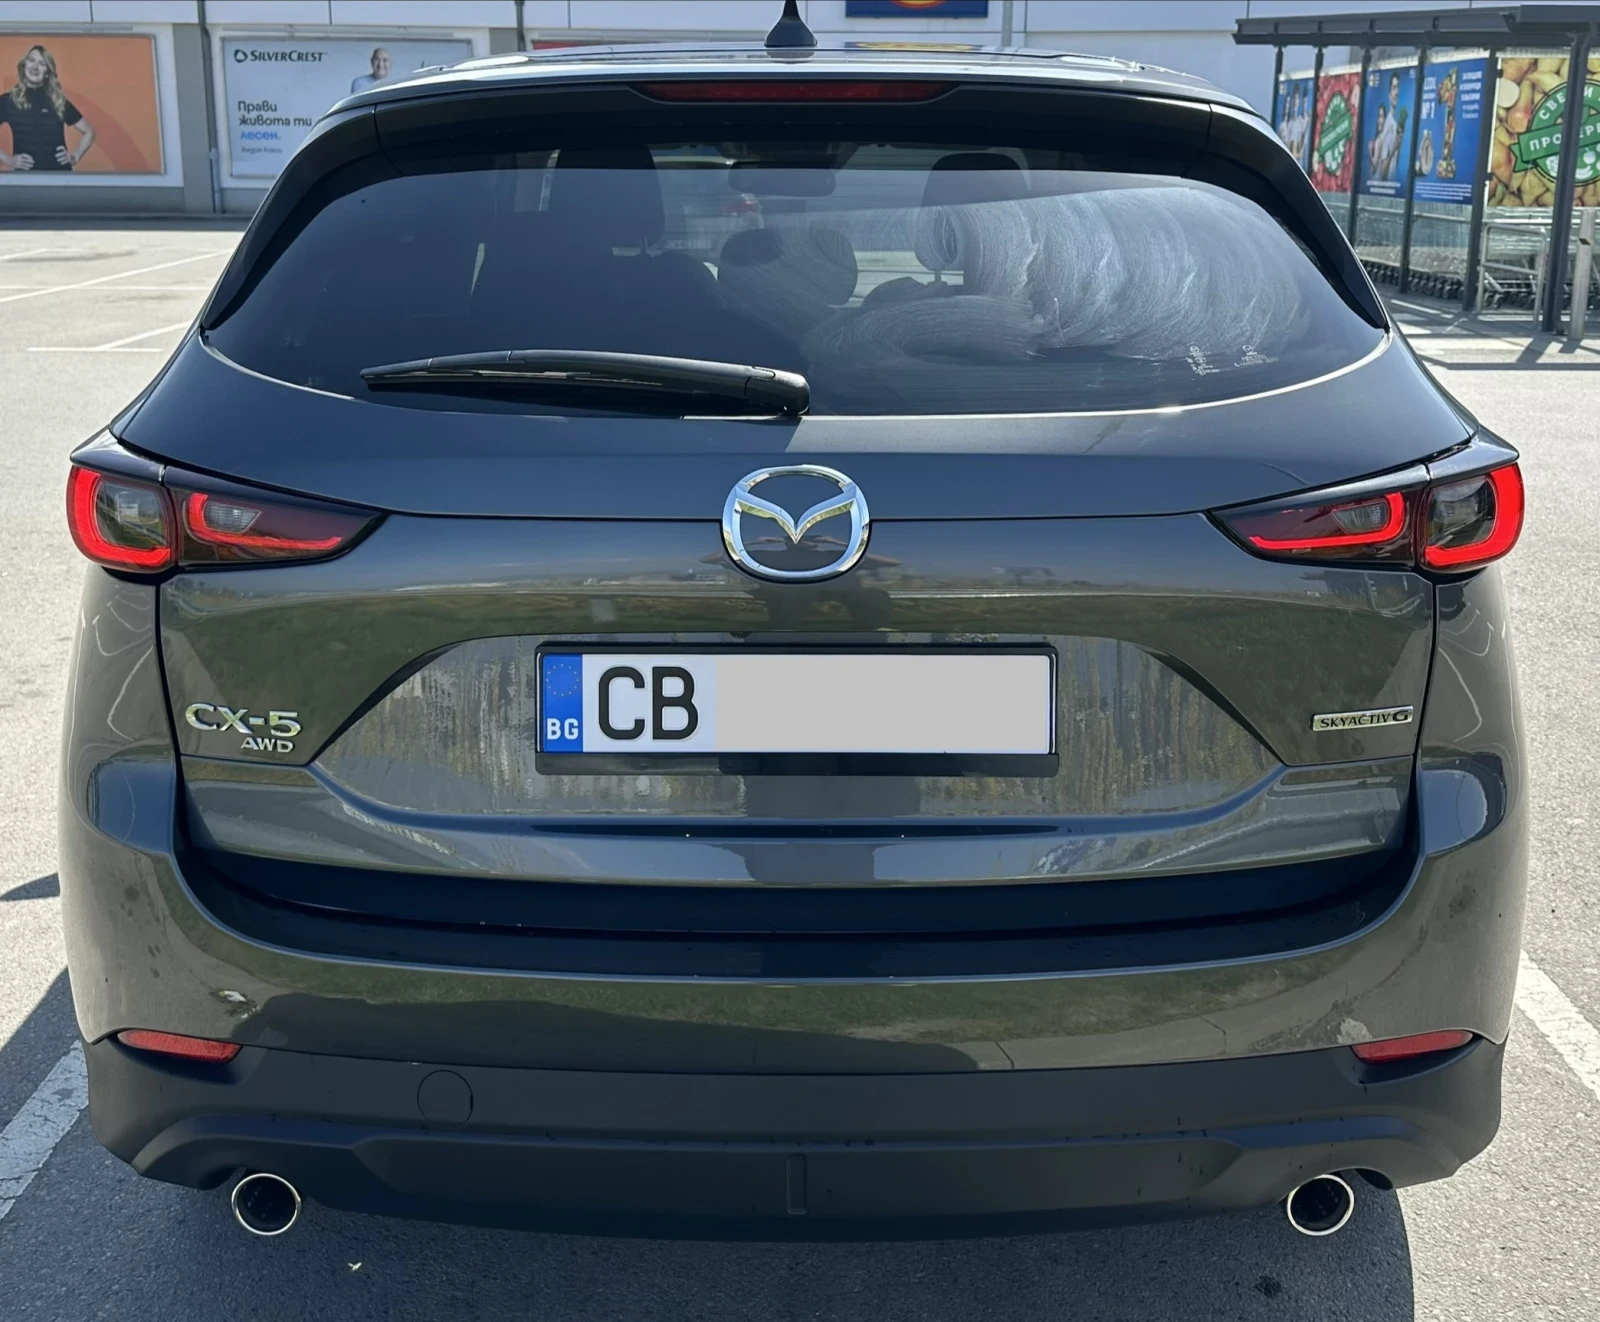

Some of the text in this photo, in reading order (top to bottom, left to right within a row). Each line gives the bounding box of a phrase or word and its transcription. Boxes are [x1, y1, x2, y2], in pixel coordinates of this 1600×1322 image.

[238, 100, 277, 115] Прави
[1539, 85, 1593, 119] СВЕИ
[239, 115, 312, 127] живота ти
[598, 666, 699, 740] CB
[185, 703, 302, 738] CX-5
[546, 717, 579, 740] BG
[241, 736, 294, 753] AWD
